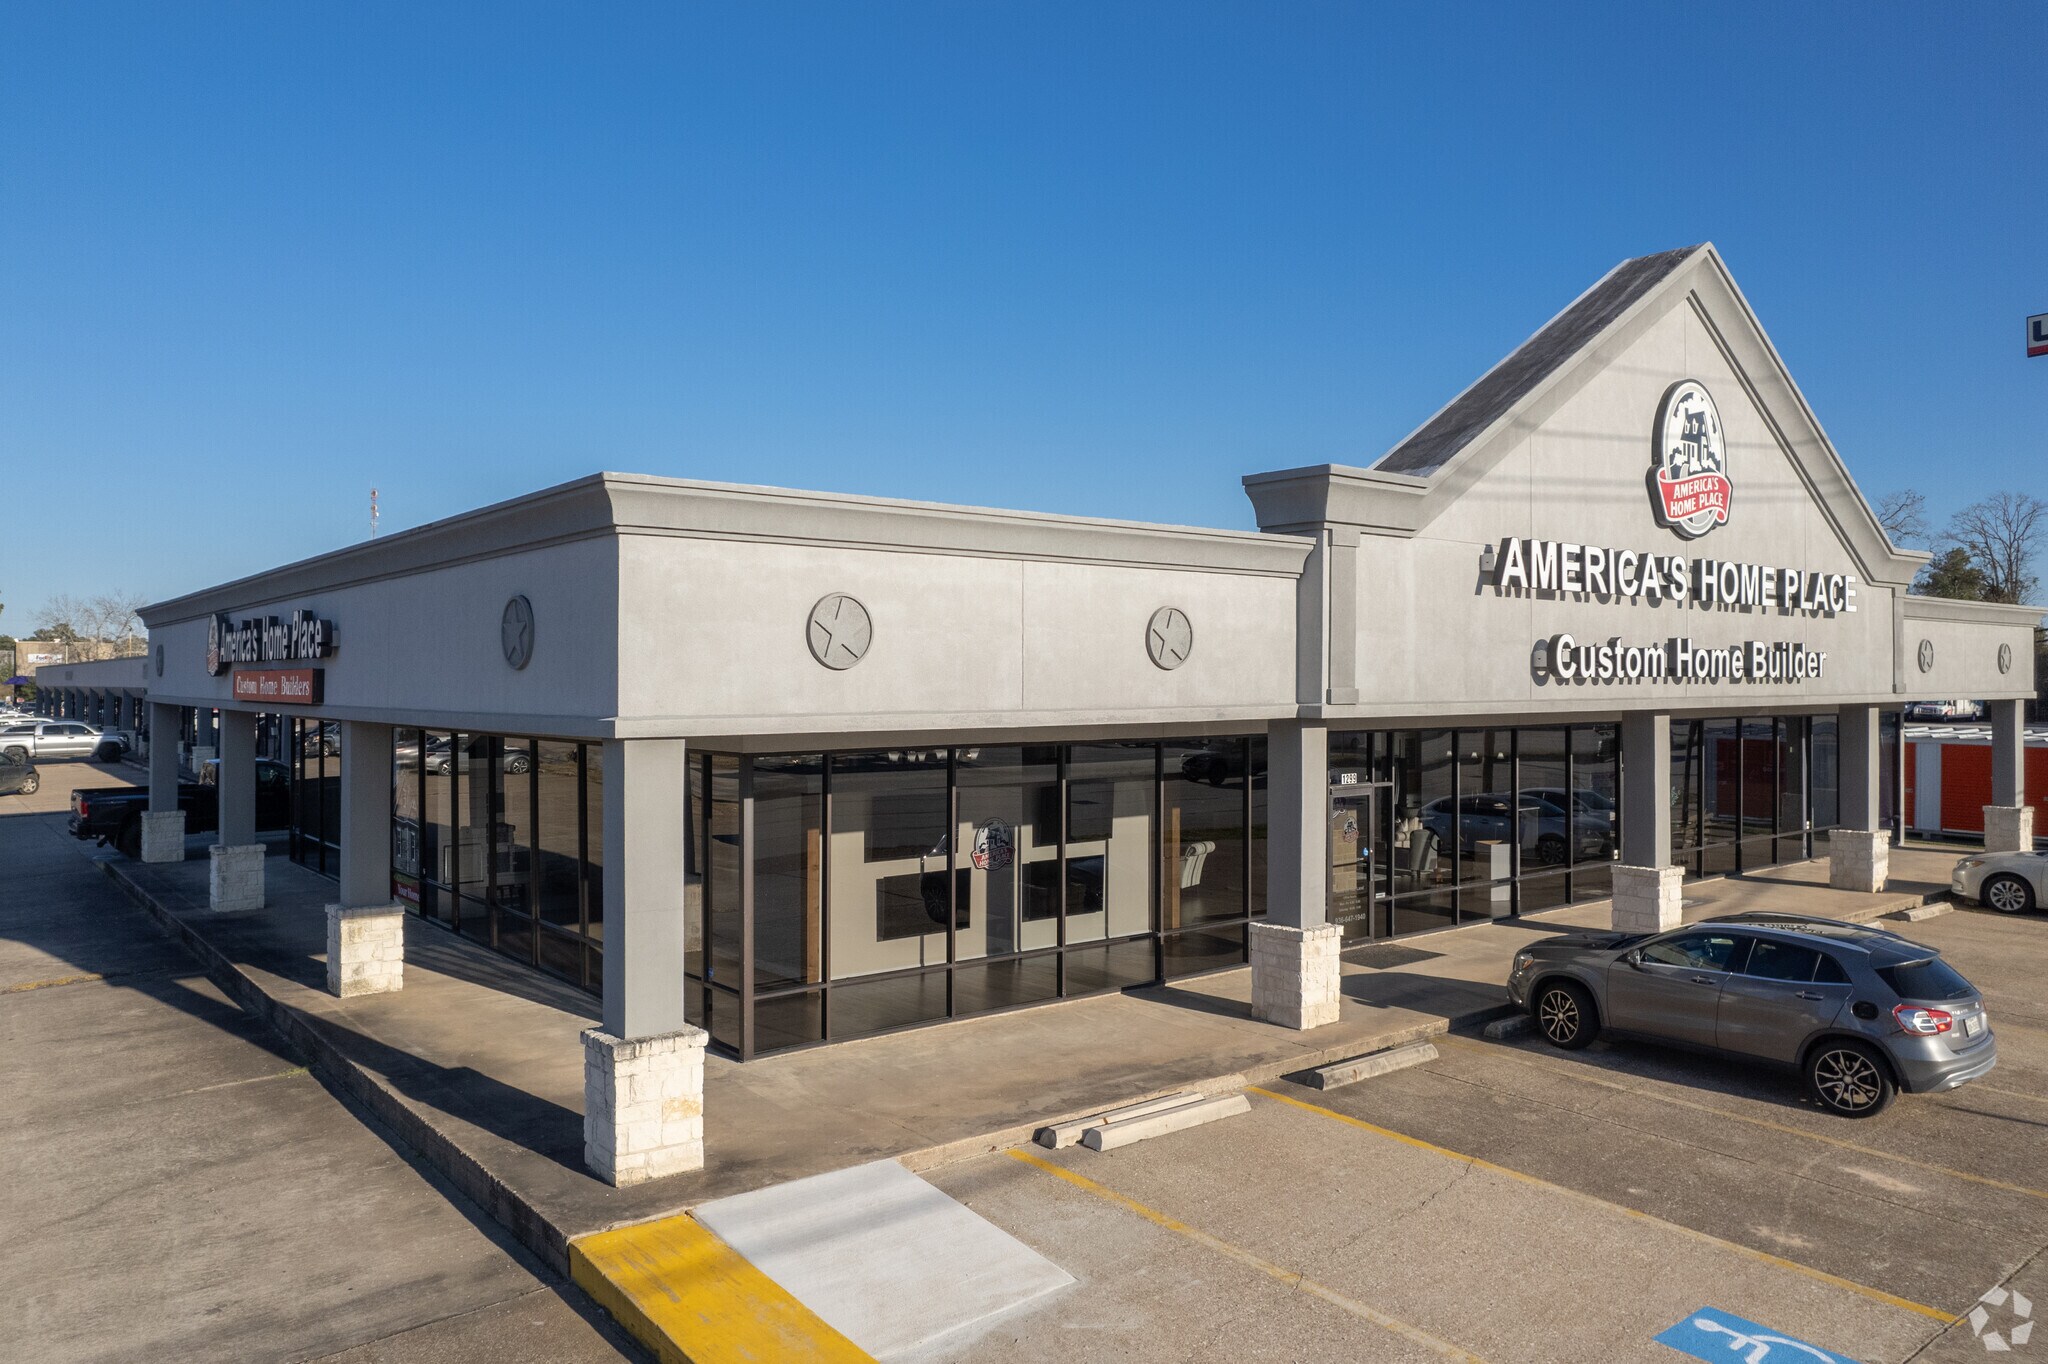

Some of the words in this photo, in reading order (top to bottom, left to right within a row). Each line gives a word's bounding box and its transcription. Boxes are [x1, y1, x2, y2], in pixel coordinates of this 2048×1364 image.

[1670, 497, 1697, 516] HOME
[1699, 492, 1724, 509] PLACE
[1673, 477, 1719, 499] AMERICA'S
[1499, 537, 1689, 600] AMERICA'S
[1699, 558, 1777, 606] HOME
[1779, 569, 1858, 612] PLACE
[220, 618, 258, 662] America's
[262, 616, 288, 660] Home
[291, 610, 322, 658] Place
[1556, 634, 1667, 678] Custom
[1676, 638, 1744, 678] Home
[1751, 641, 1827, 678] Builder
[236, 676, 257, 694] Custom
[260, 676, 278, 695] Home
[281, 676, 310, 695] Builders
